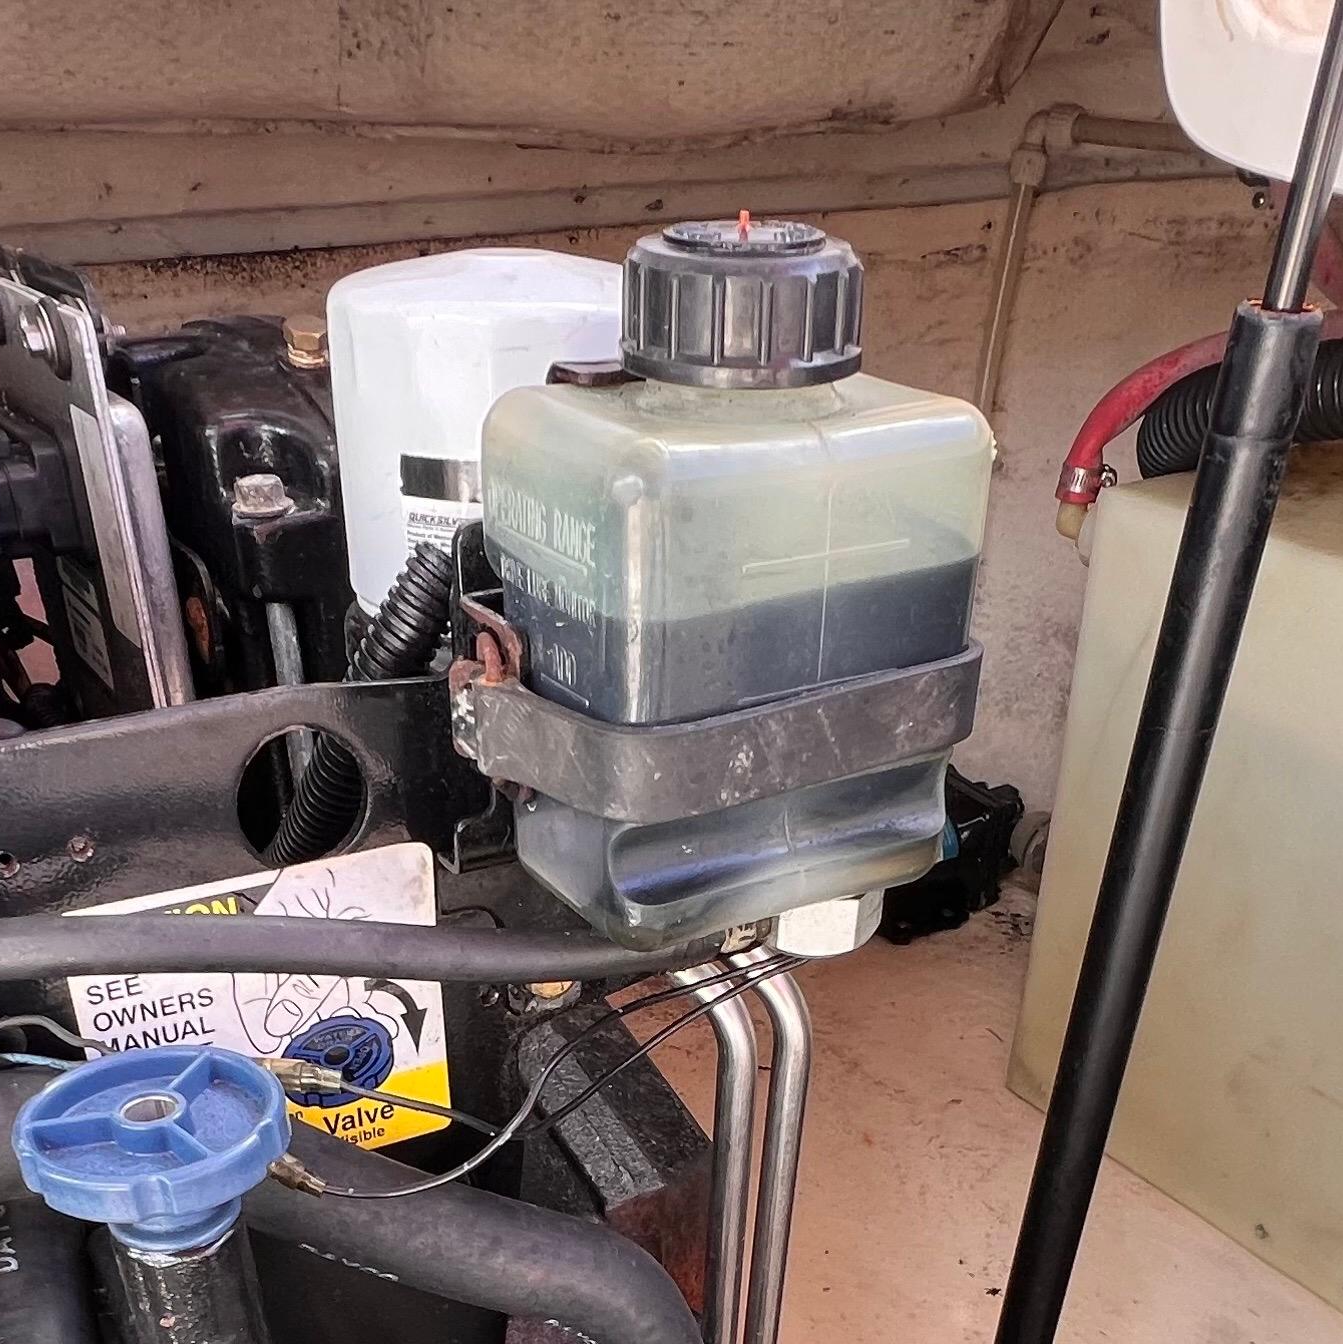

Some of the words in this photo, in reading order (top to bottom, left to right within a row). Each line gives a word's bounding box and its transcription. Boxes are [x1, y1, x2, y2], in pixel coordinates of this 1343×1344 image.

[553, 508, 597, 570] RANGE
[86, 975, 143, 1005] SEE
[93, 987, 214, 1032] OWNERS
[322, 1103, 395, 1136] Valve
